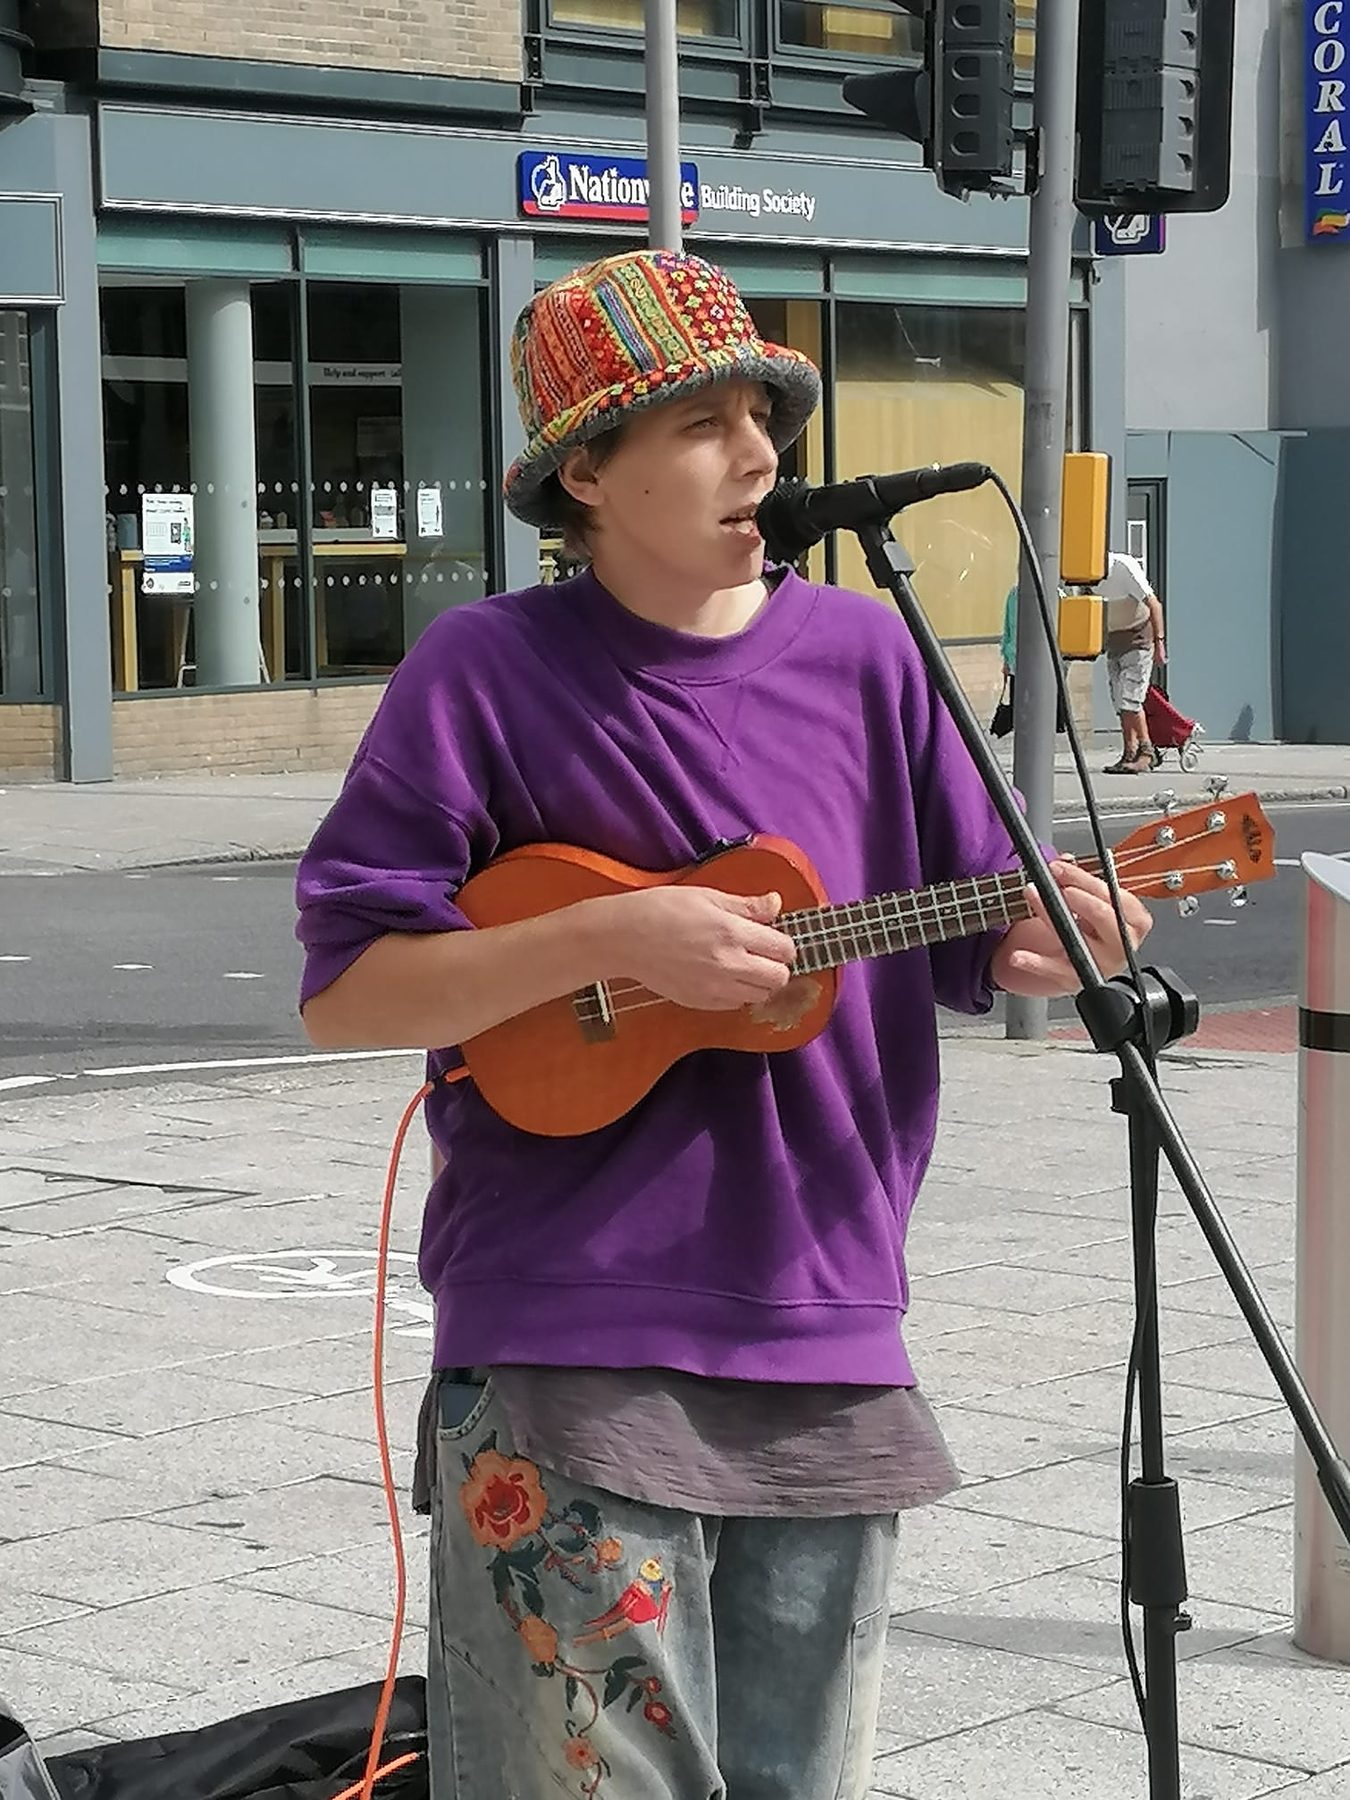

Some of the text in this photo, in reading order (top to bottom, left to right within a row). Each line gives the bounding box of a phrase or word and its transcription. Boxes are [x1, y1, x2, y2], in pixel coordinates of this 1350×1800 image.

[1313, 1, 1346, 195] CORAL
[569, 164, 815, 222] Natione Building Society
